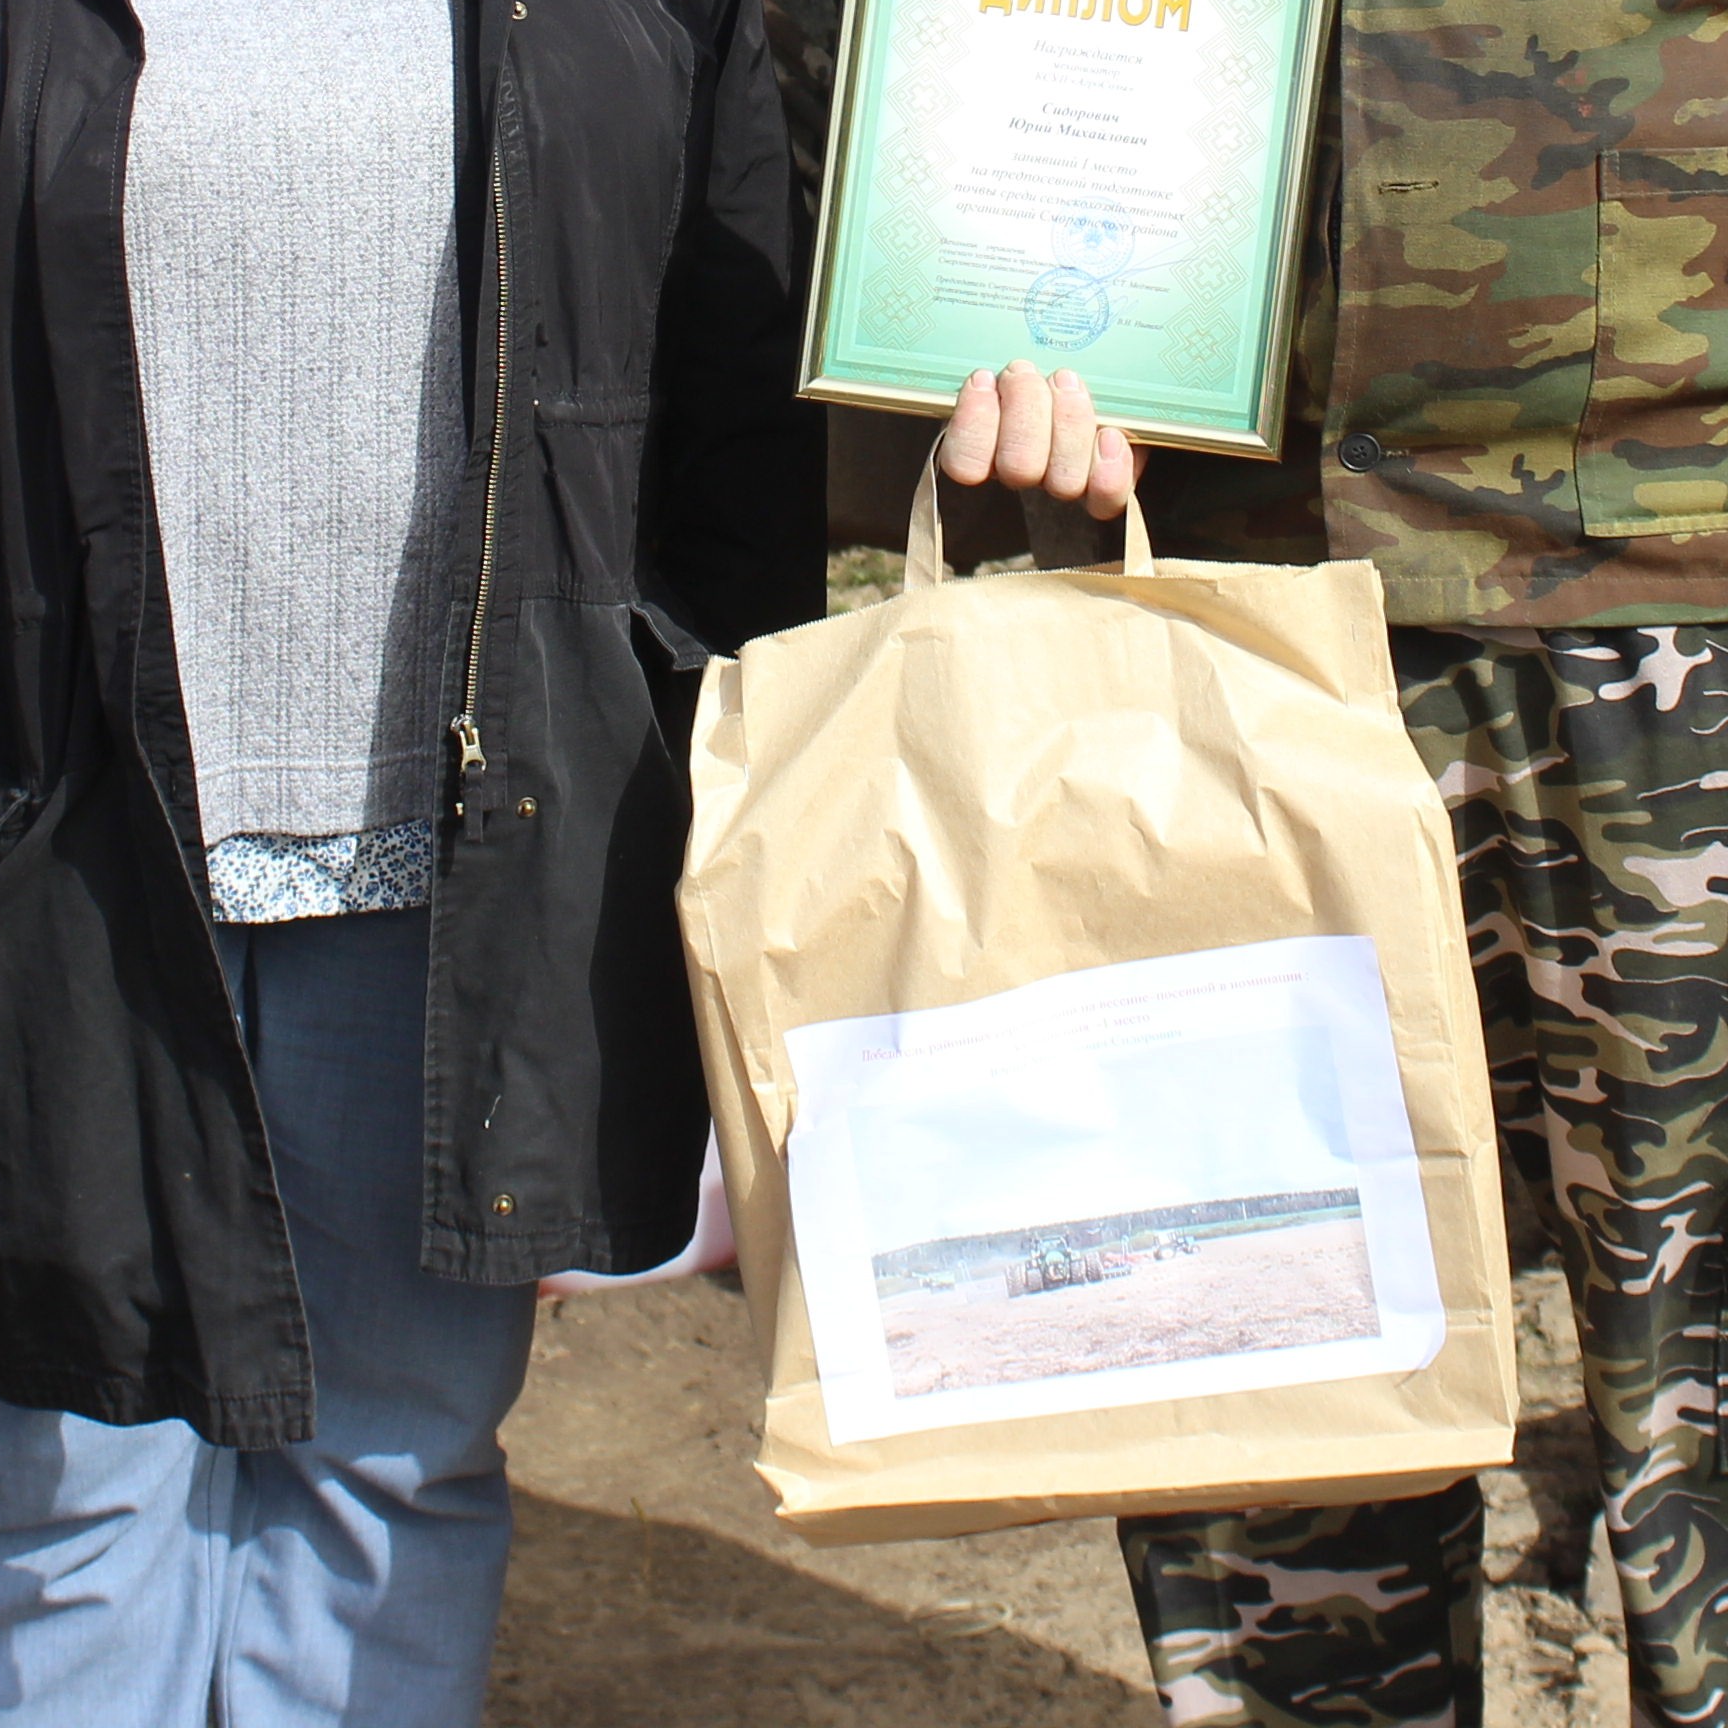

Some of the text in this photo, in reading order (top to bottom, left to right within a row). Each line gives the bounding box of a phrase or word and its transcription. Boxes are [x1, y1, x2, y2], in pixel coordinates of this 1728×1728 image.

[1033, 39, 1144, 65] Награждается
[1042, 102, 1120, 123] Сидорович
[1008, 117, 1148, 147] Юрий Михайлович
[1011, 149, 1078, 169] занявший
[1092, 162, 1137, 177] место
[970, 165, 1174, 201] на предпосевной подготовке
[953, 182, 1186, 223] почвы среди сельскохозяйственных
[955, 200, 1178, 241] организаций Сморгонского района
[1229, 968, 1303, 993] номинации
[1112, 1012, 1151, 1029] место
